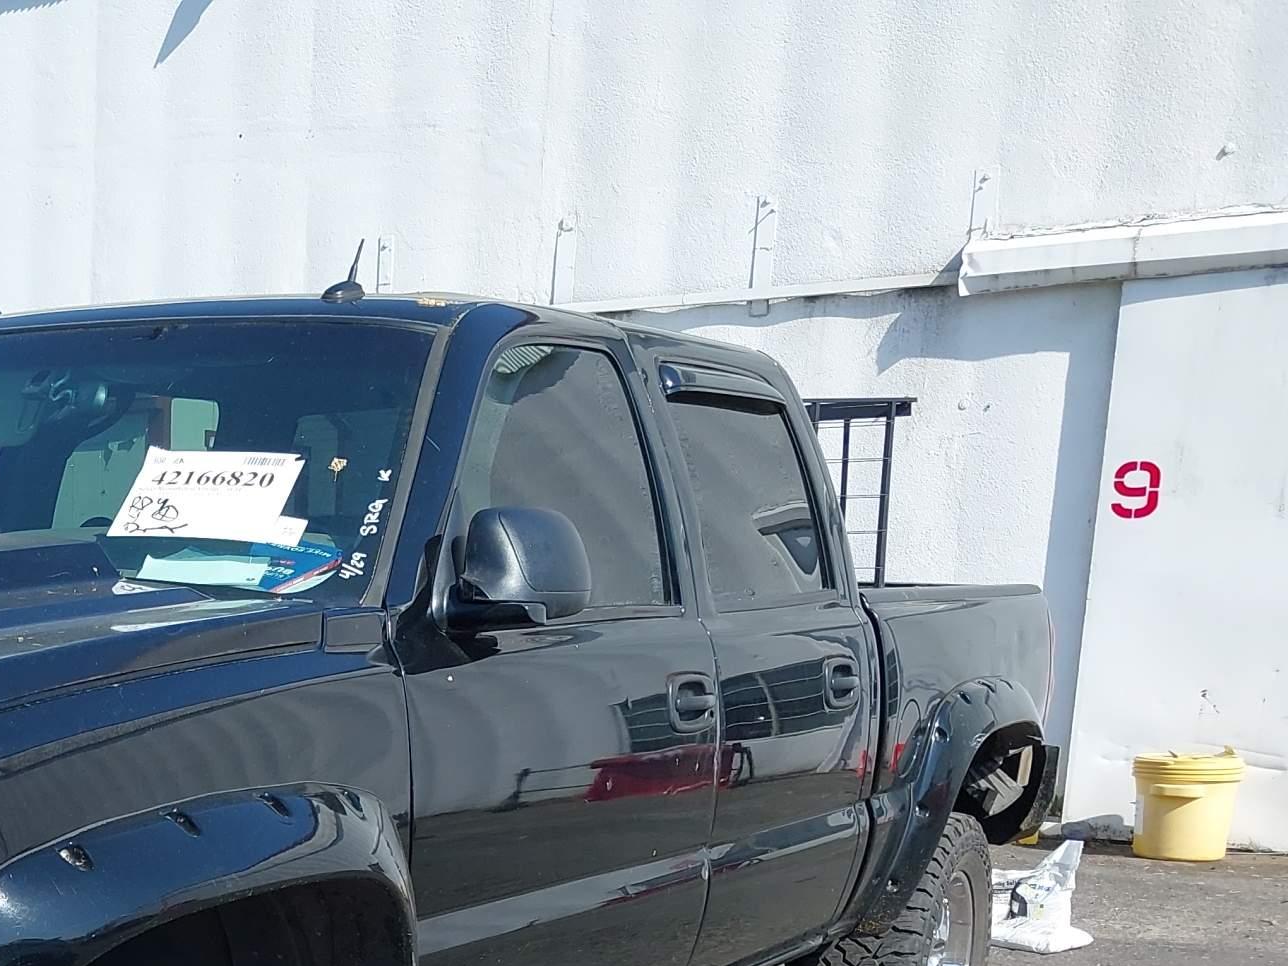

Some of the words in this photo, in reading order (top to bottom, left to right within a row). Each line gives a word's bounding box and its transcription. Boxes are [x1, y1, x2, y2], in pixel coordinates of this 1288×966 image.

[152, 470, 275, 488] 42166820
[1111, 461, 1161, 518] 9
[338, 552, 367, 579] 4/29
